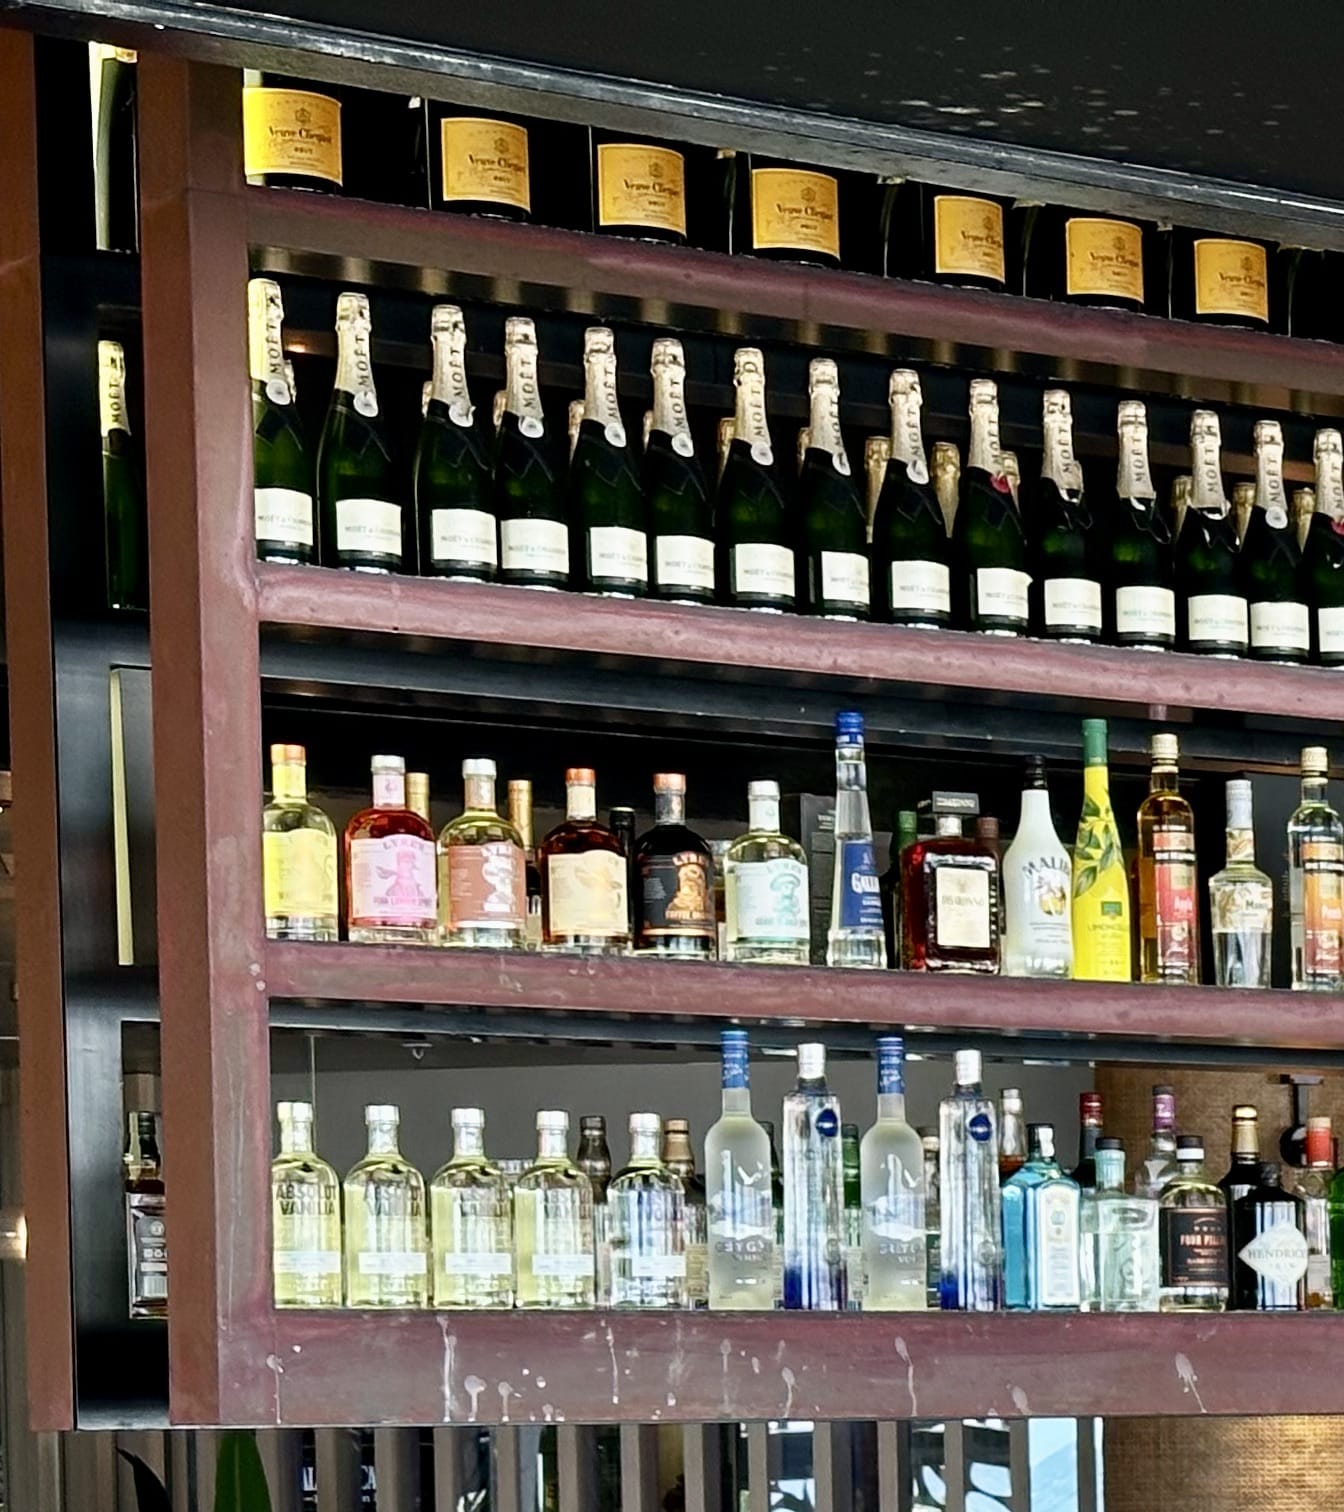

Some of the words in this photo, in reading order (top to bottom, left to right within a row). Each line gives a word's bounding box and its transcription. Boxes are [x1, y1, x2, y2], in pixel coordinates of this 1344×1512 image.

[265, 322, 282, 376] MOËT
[519, 358, 537, 409] MOËT
[669, 379, 686, 429] MOËT
[276, 1184, 336, 1200] ABSOLUT
